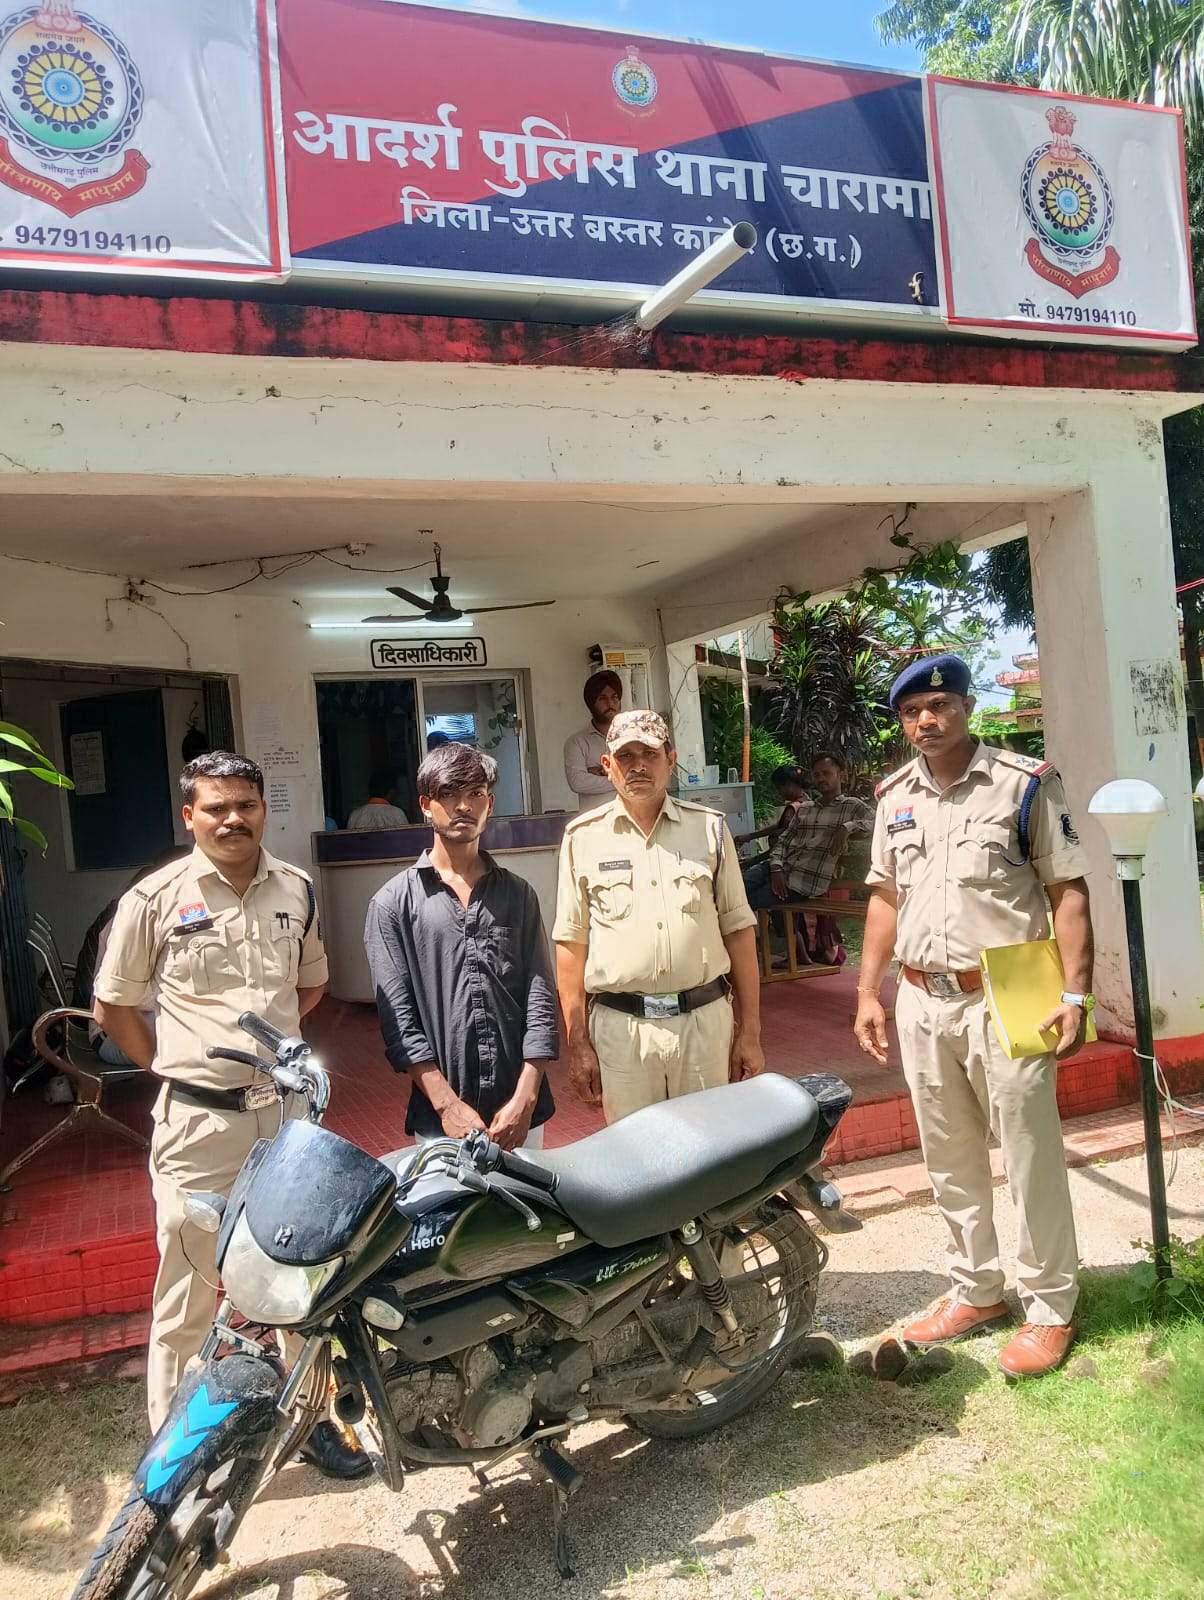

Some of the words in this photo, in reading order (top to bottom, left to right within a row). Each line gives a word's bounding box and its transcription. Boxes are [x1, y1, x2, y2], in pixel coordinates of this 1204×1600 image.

[293, 103, 462, 170] आदर्श
[478, 115, 640, 198] पुलिस
[655, 149, 768, 202] थाना
[781, 164, 931, 220] चारामा
[15, 225, 171, 254] 9479194110
[399, 185, 575, 239] जिला-उत्तर
[582, 213, 664, 247] बस्तर
[765, 227, 862, 269] (छ.ग.)
[1018, 298, 1040, 319] मो.
[1046, 305, 1137, 326] 9479194110
[378, 642, 478, 664] दिवसाधिकारी
[411, 1234, 446, 1251] Hero
